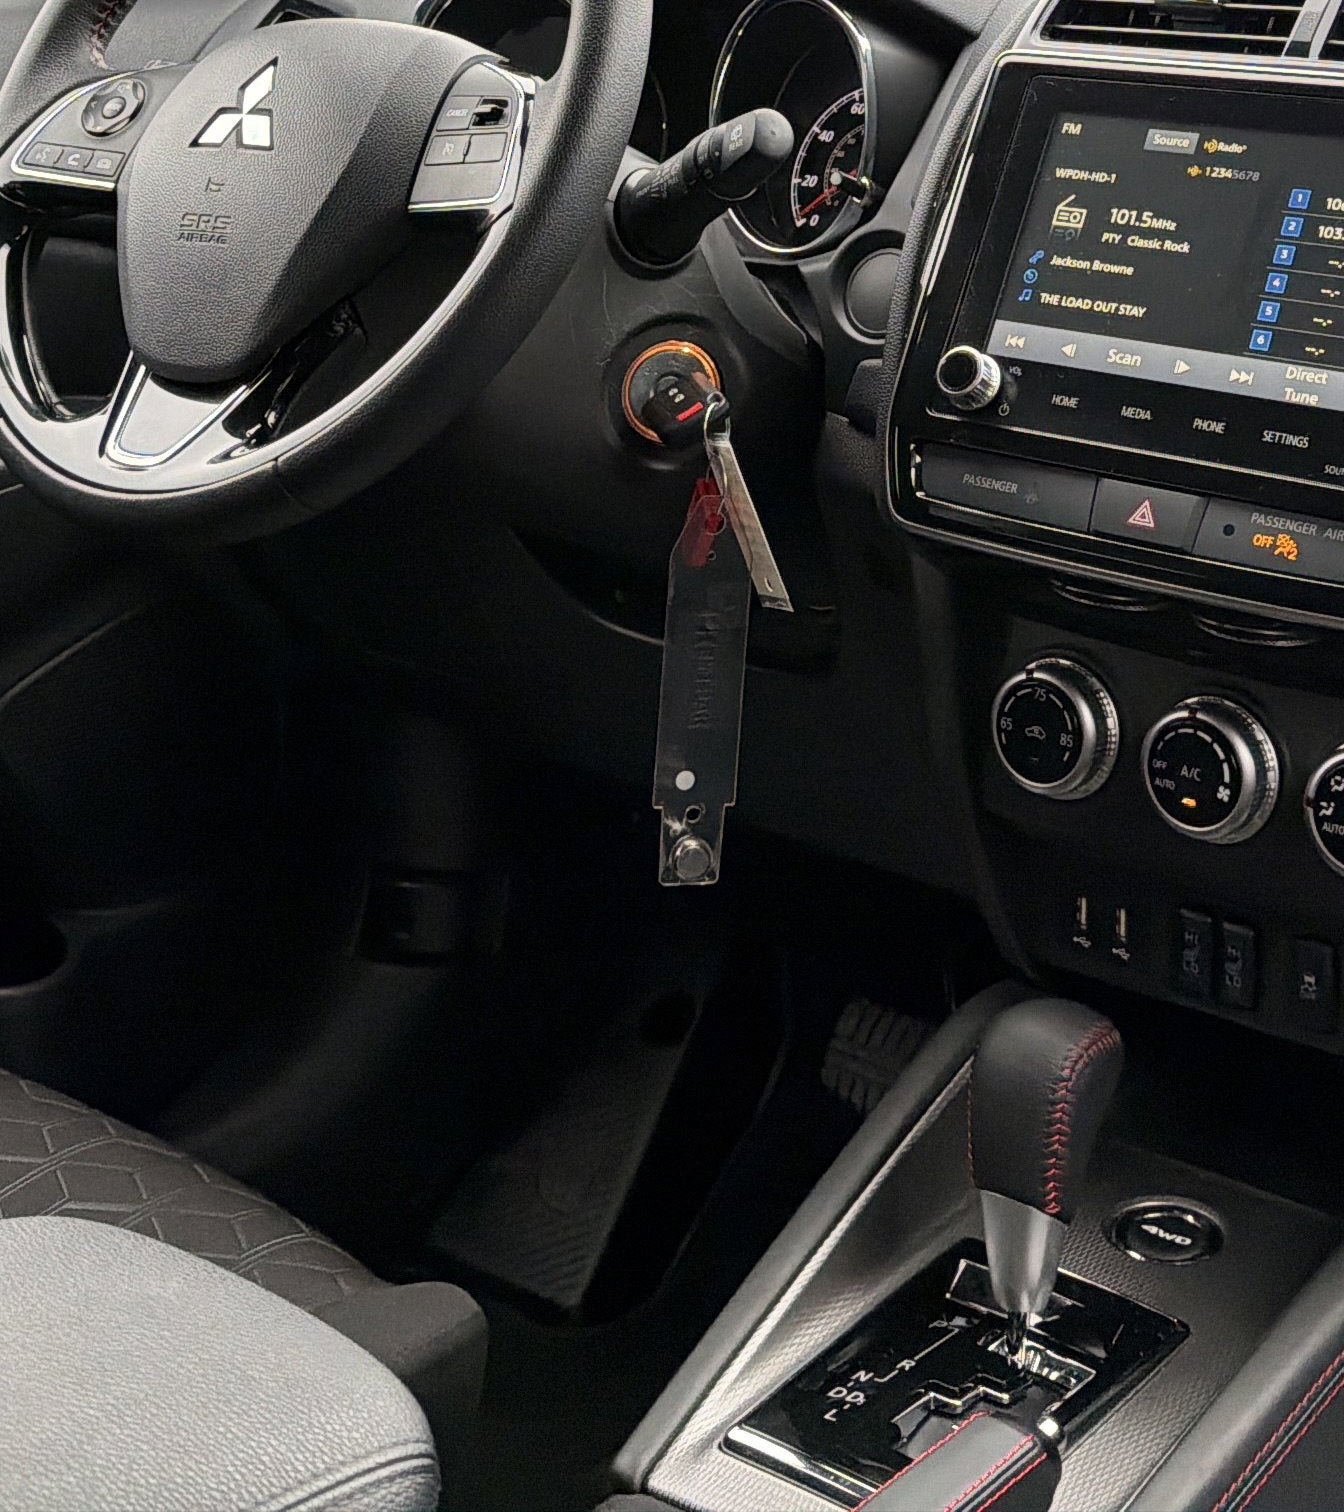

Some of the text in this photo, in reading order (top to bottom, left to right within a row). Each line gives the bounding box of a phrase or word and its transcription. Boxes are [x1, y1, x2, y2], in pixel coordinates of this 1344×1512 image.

[818, 130, 835, 142] 40
[1061, 122, 1083, 135] FM
[1152, 134, 1190, 148] Source
[801, 174, 818, 187] 20
[1055, 167, 1117, 184] WPDH-HD-1
[180, 212, 232, 230] SRS
[809, 214, 819, 226] 0
[176, 232, 229, 245] AIRBAG
[1101, 232, 1191, 254] PTY Classic Rock
[1050, 254, 1135, 276] Jackson Browne
[1039, 292, 1147, 318] THE LOAD OUT STAY
[1106, 348, 1142, 368] Scan
[1285, 366, 1329, 385] Direct
[1051, 394, 1080, 409] HOME
[1284, 387, 1319, 406] Tune
[1120, 406, 1153, 421] MEDIA
[1192, 417, 1226, 434] PHONE
[1261, 430, 1309, 449] SETTINGS
[962, 472, 1019, 495] PASSENGER
[1250, 512, 1318, 537] PASSENGER
[1252, 533, 1275, 549] OFF
[1034, 688, 1047, 701] 75
[1000, 716, 1013, 731] 65
[1059, 733, 1073, 748] 85
[1152, 758, 1168, 770] OFF
[1180, 764, 1201, 782] A/C
[1154, 777, 1176, 791] AUTO
[1185, 930, 1199, 945] HI
[1140, 1224, 1192, 1245] 4WD
[896, 1359, 916, 1371] R
[850, 1370, 874, 1382] N
[826, 1387, 848, 1398] D
[823, 1408, 839, 1422] L
